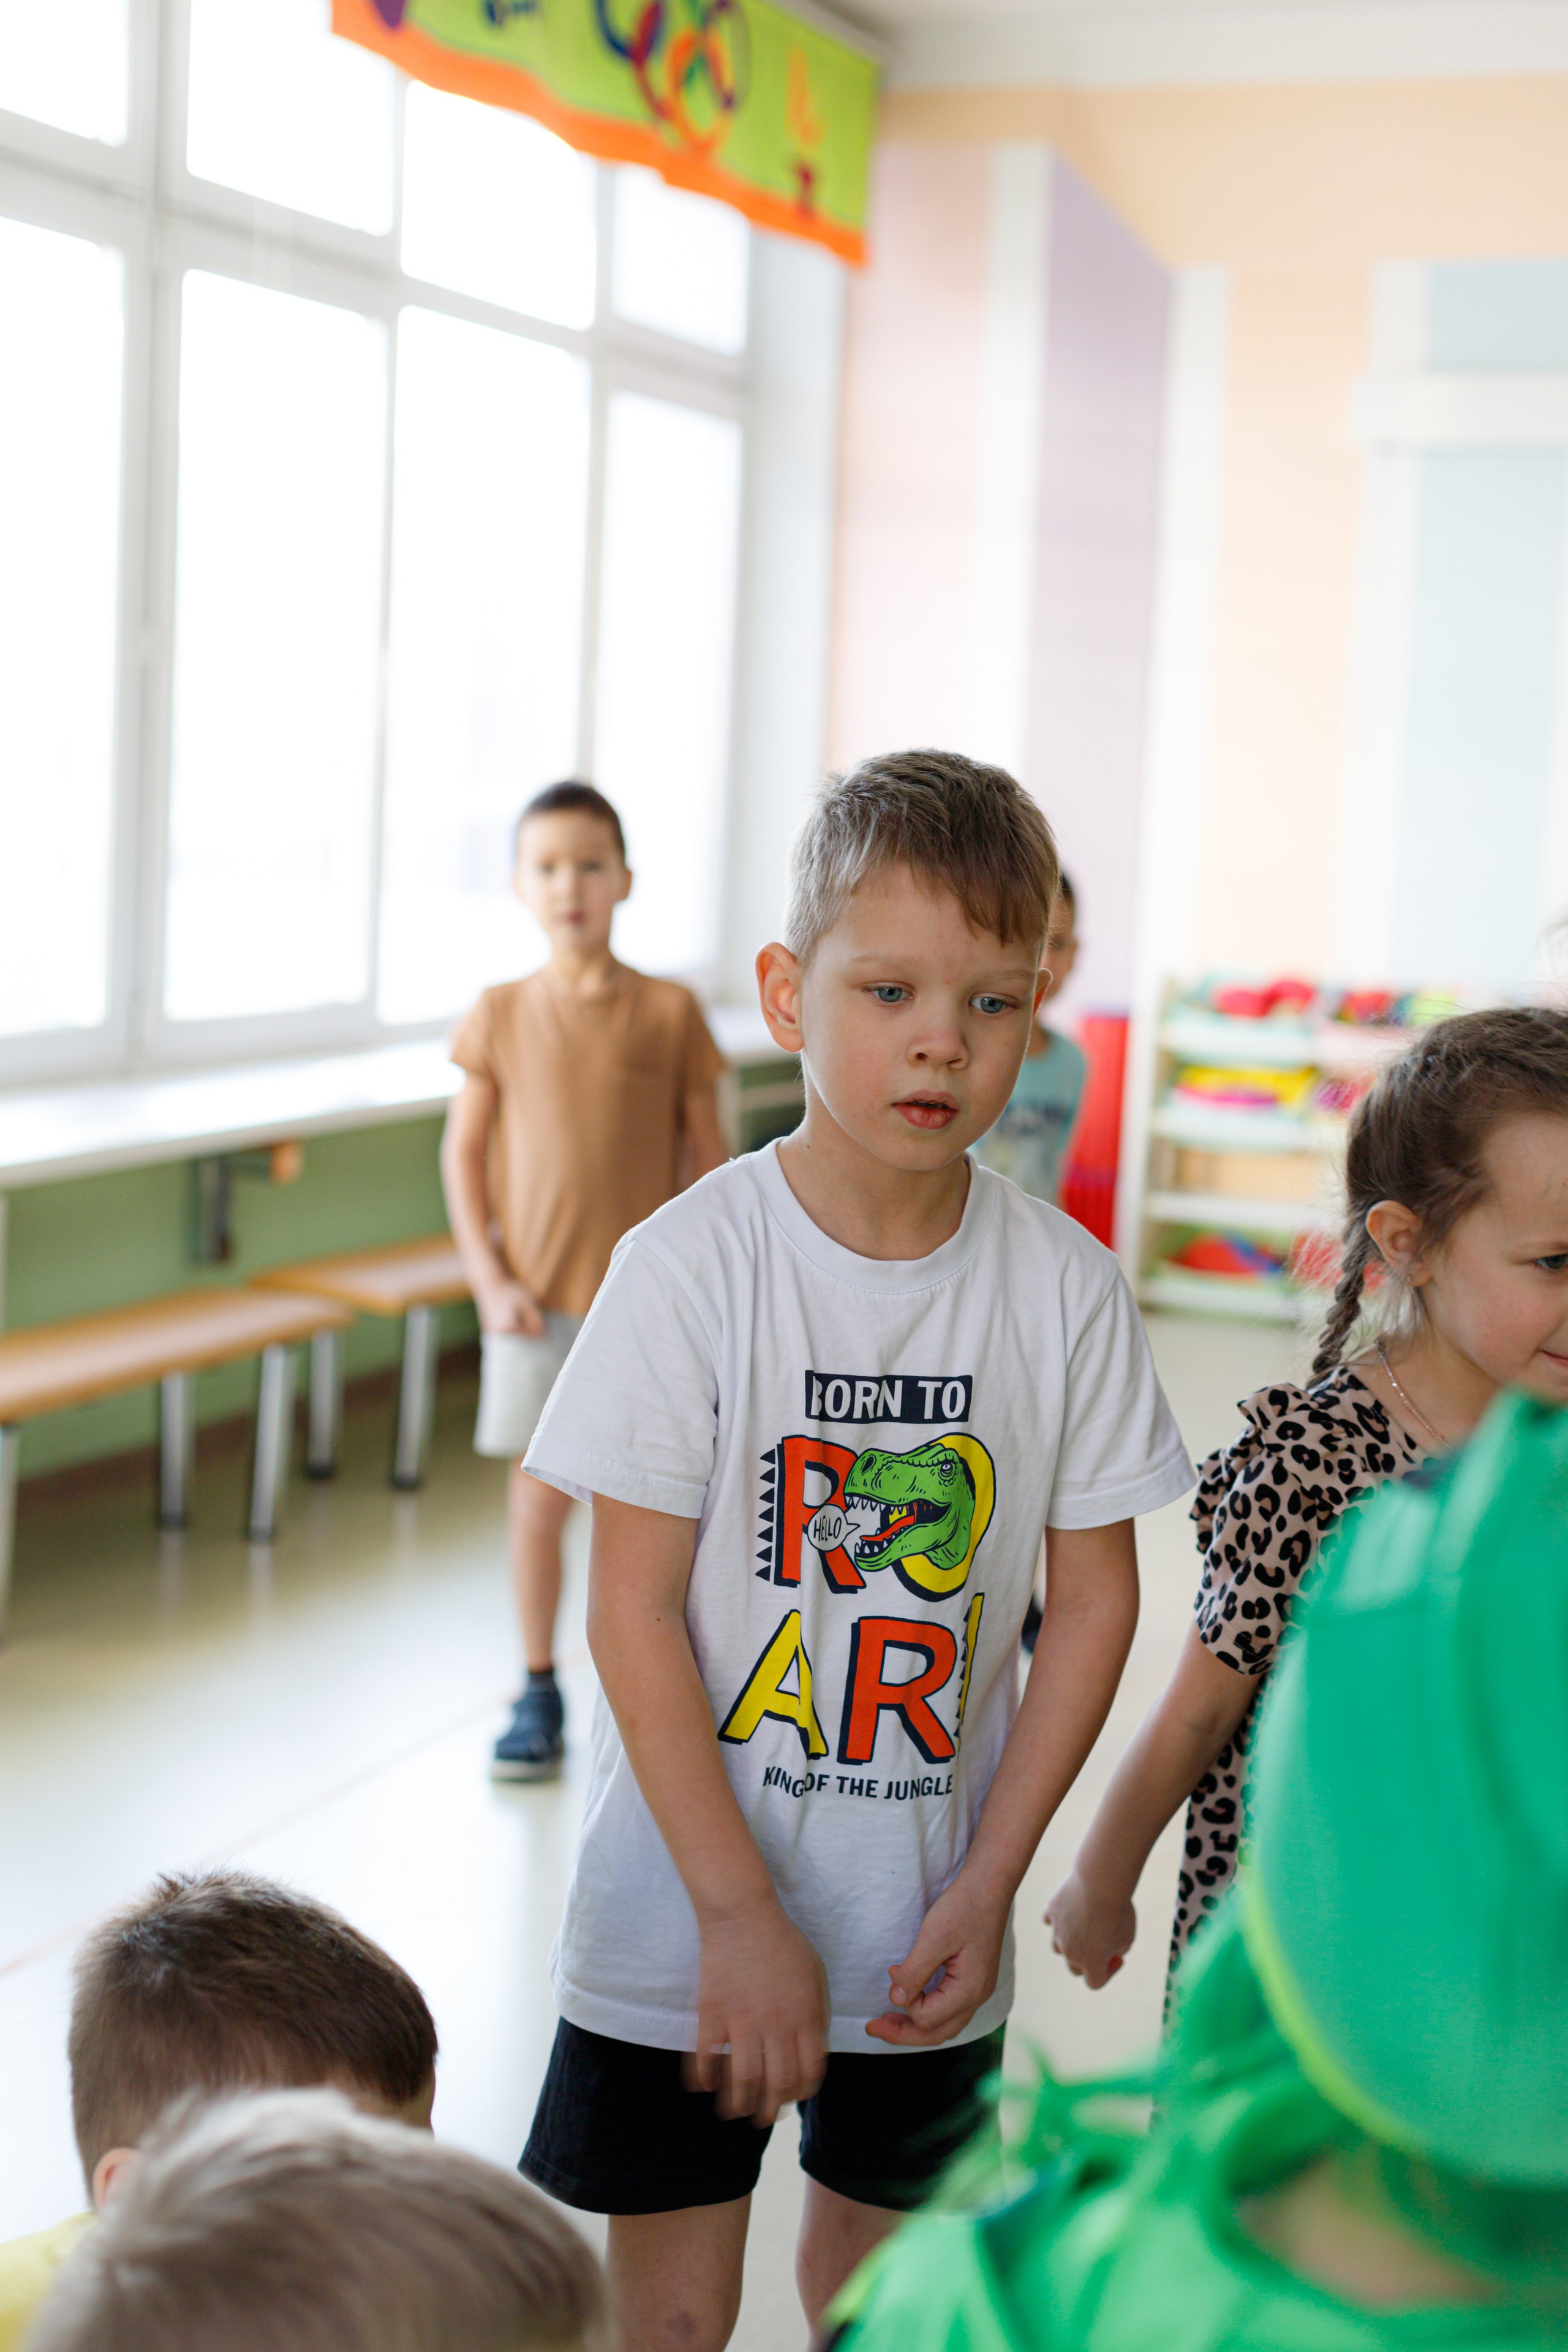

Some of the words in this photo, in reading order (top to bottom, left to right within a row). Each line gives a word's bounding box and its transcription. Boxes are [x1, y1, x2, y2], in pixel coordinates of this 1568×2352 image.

[810, 1376, 903, 1419] BORN
[918, 1380, 966, 1420] TO
[813, 1515, 842, 1542] HELLO
[763, 1766, 805, 1798] KING
[804, 1773, 830, 1792] OF
[836, 1776, 879, 1798] THE
[884, 1774, 953, 1801] JUNGLE
